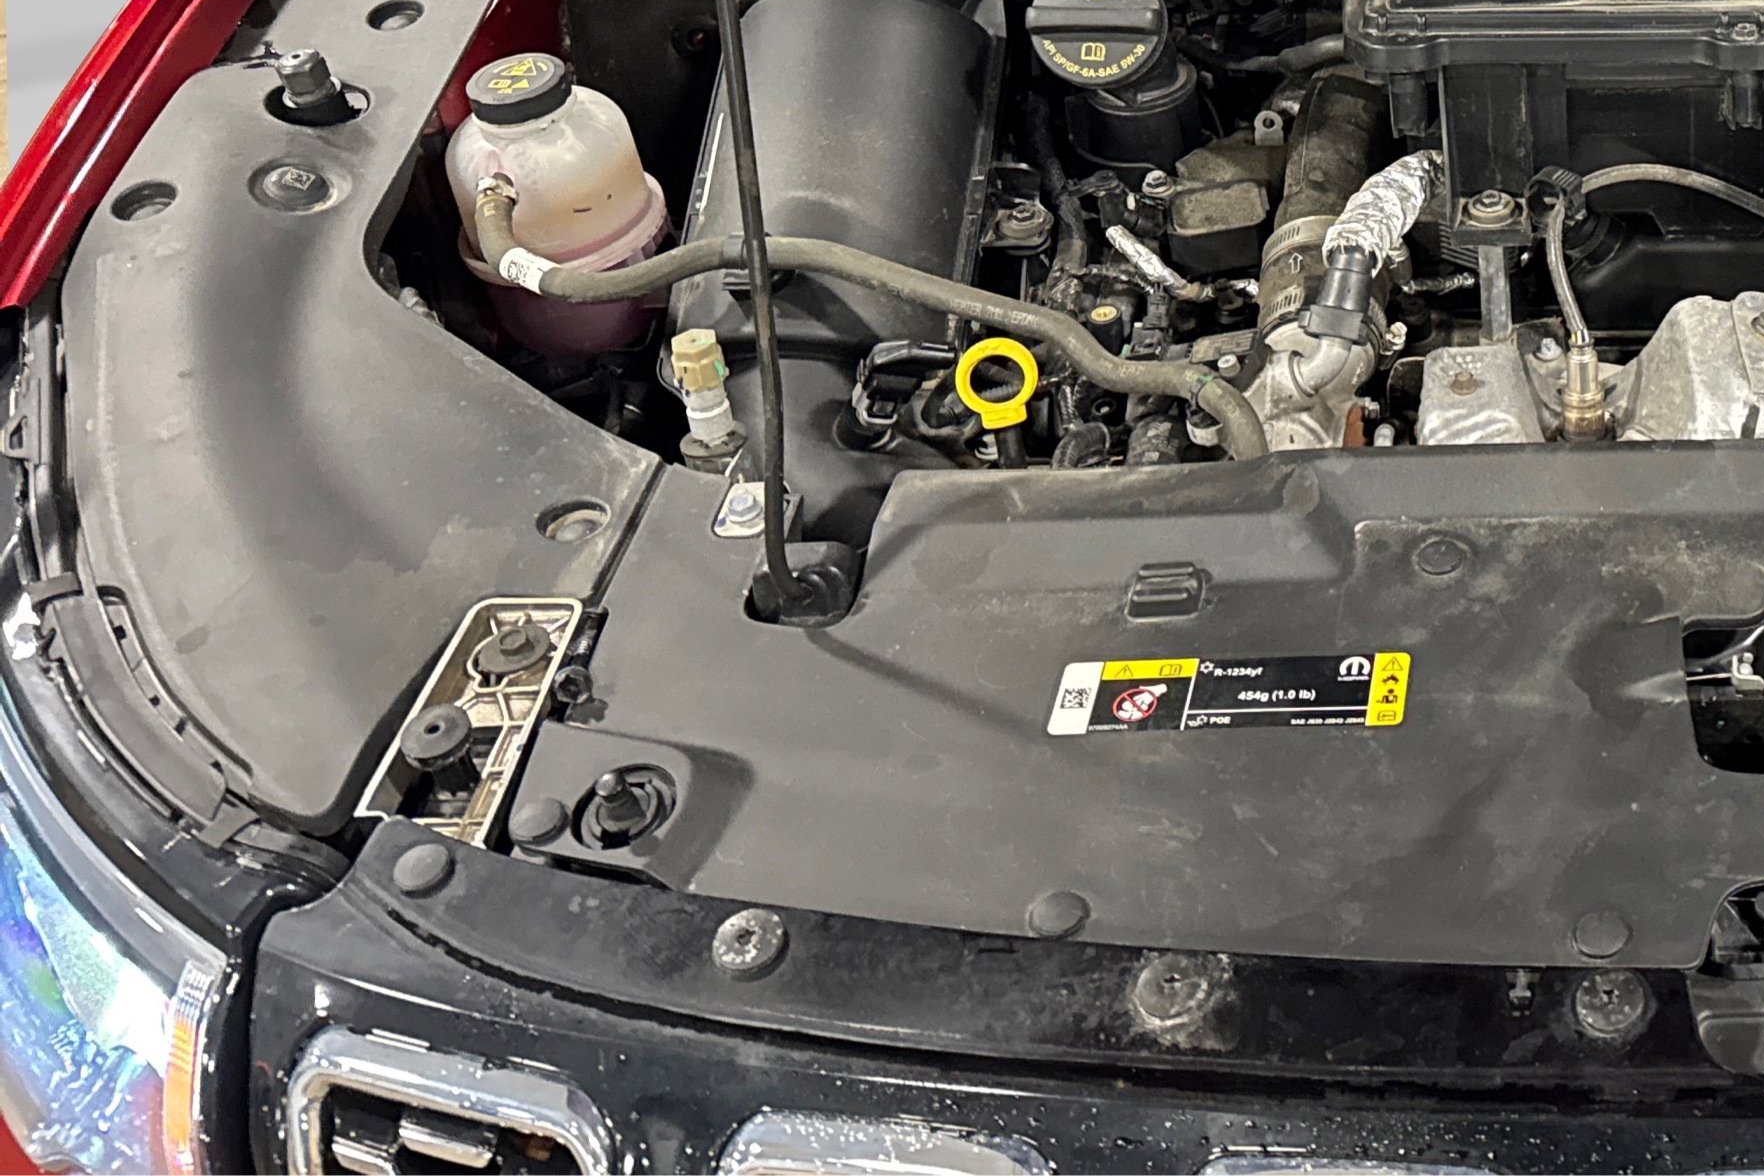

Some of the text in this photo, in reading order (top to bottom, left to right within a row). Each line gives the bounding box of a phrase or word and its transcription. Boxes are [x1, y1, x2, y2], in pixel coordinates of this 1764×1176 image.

[1042, 39, 1057, 56] API
[1120, 43, 1146, 69] 5W-30
[1213, 666, 1263, 677] R-1234yf
[1237, 689, 1316, 702] 454g (1.0 lb)
[1209, 716, 1232, 724] POE
